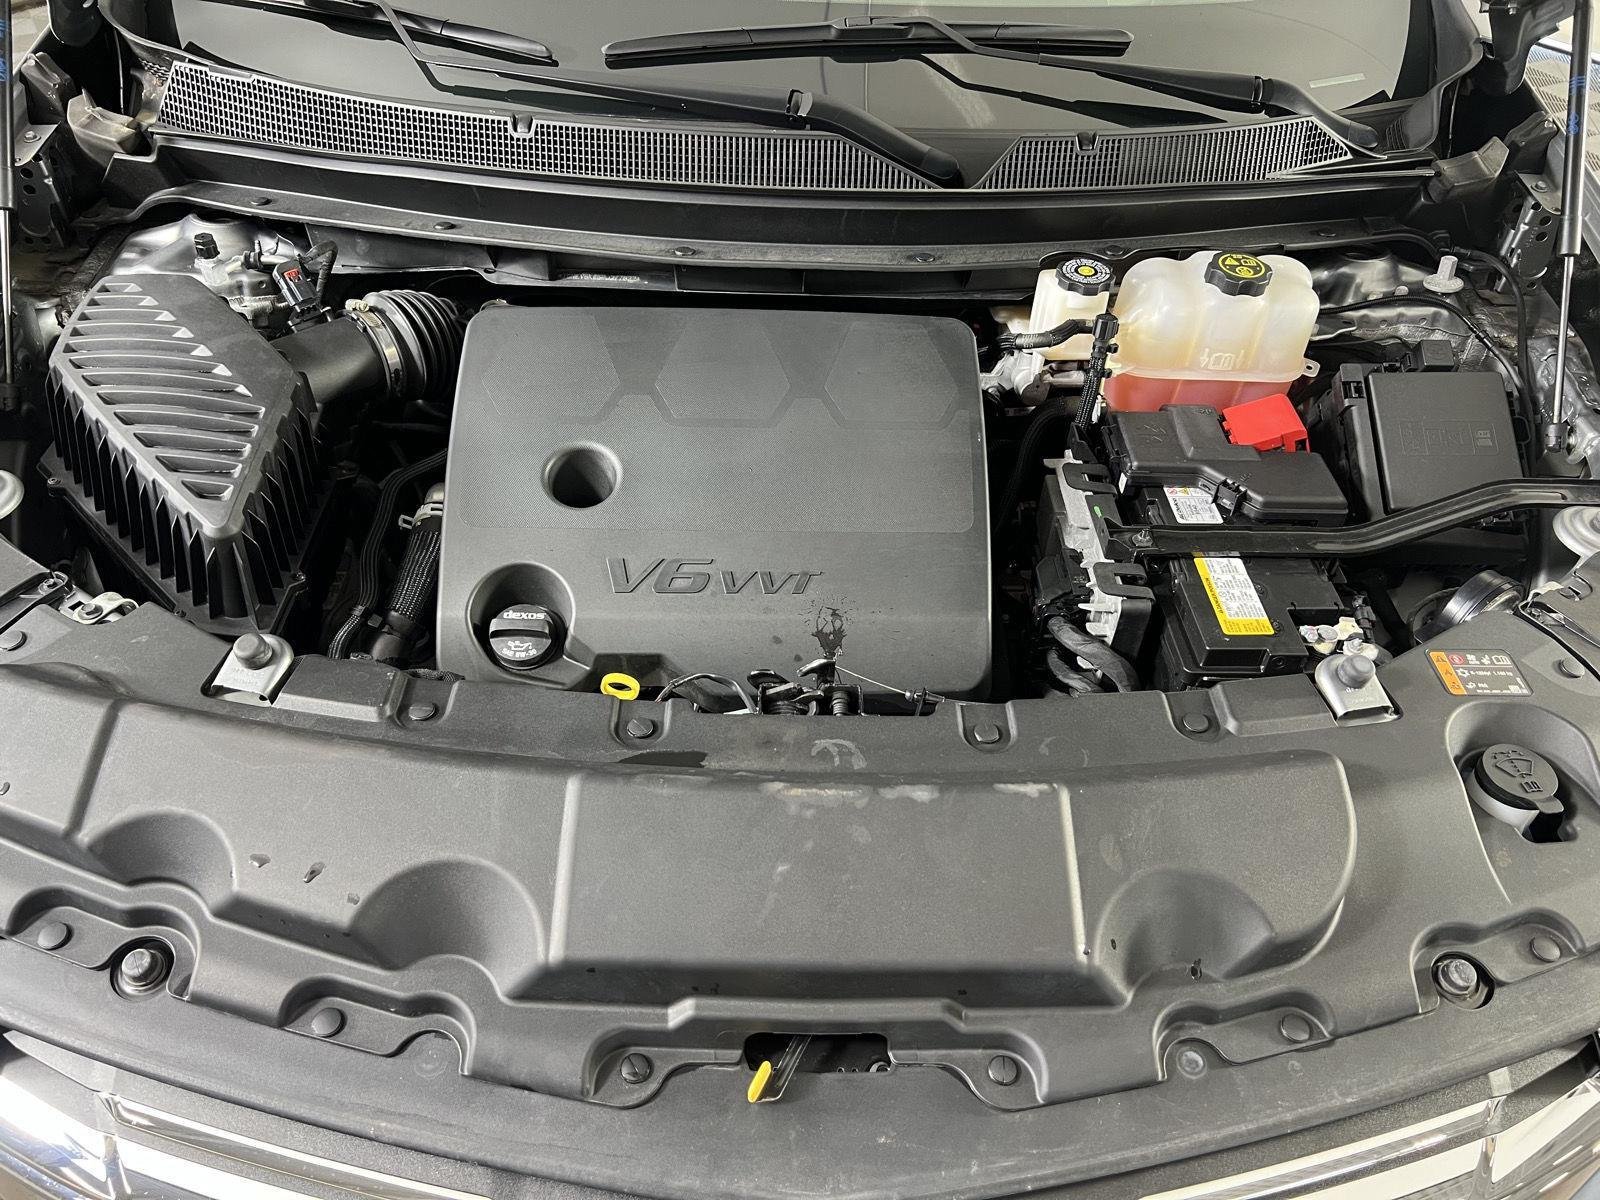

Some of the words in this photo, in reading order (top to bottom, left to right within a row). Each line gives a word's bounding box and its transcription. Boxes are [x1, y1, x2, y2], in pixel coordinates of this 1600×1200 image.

[606, 558, 714, 594] V6
[720, 570, 824, 595] VVT
[503, 609, 545, 620] dexos
